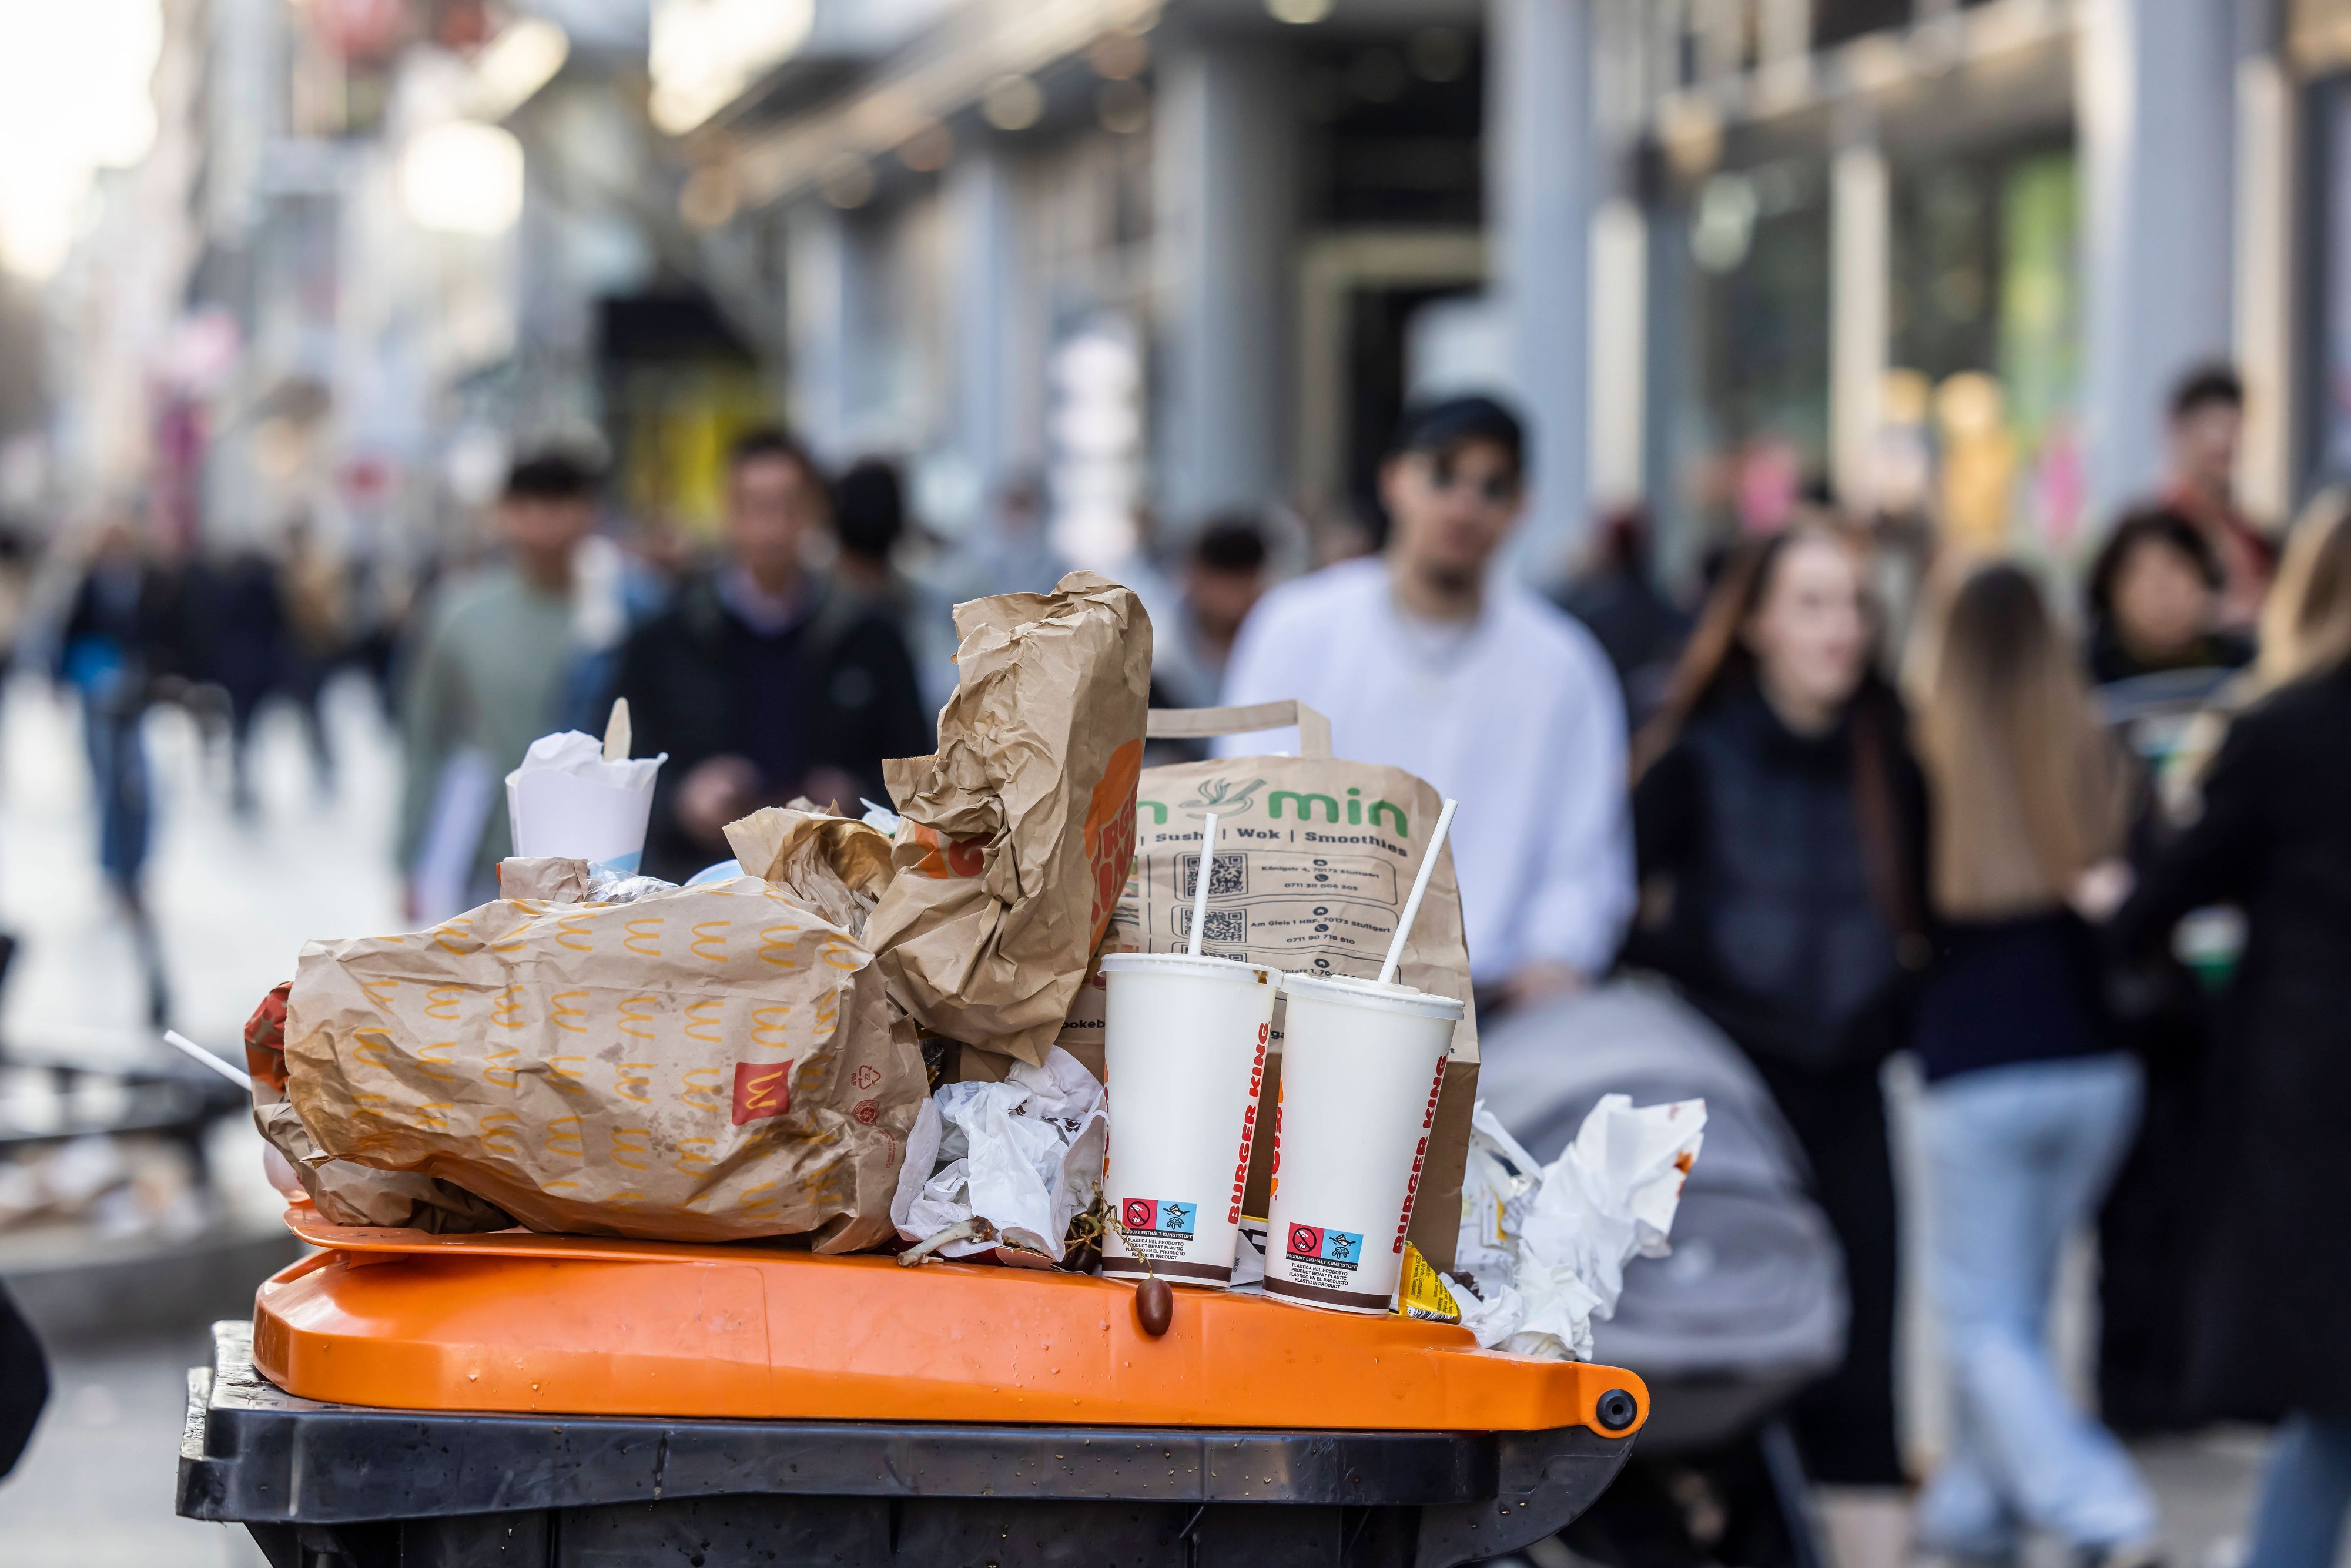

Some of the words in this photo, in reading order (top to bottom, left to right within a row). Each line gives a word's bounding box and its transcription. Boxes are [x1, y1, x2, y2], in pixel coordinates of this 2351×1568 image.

[1268, 787, 1408, 839] min
[1156, 831, 1205, 842] Sush
[1237, 828, 1280, 840] Wok
[1305, 832, 1408, 857] Smoothies
[1351, 920, 1391, 933] Stuttgart
[1060, 1019, 1106, 1030] pokeb
[1228, 1105, 1257, 1224] BURGER
[1249, 1022, 1268, 1097] KING
[1392, 1136, 1428, 1254] BURGER
[1422, 1055, 1448, 1129] KING
[1327, 1260, 1357, 1269] KUNSTSTOFF
[1323, 1278, 1348, 1286] PRODUCTO
